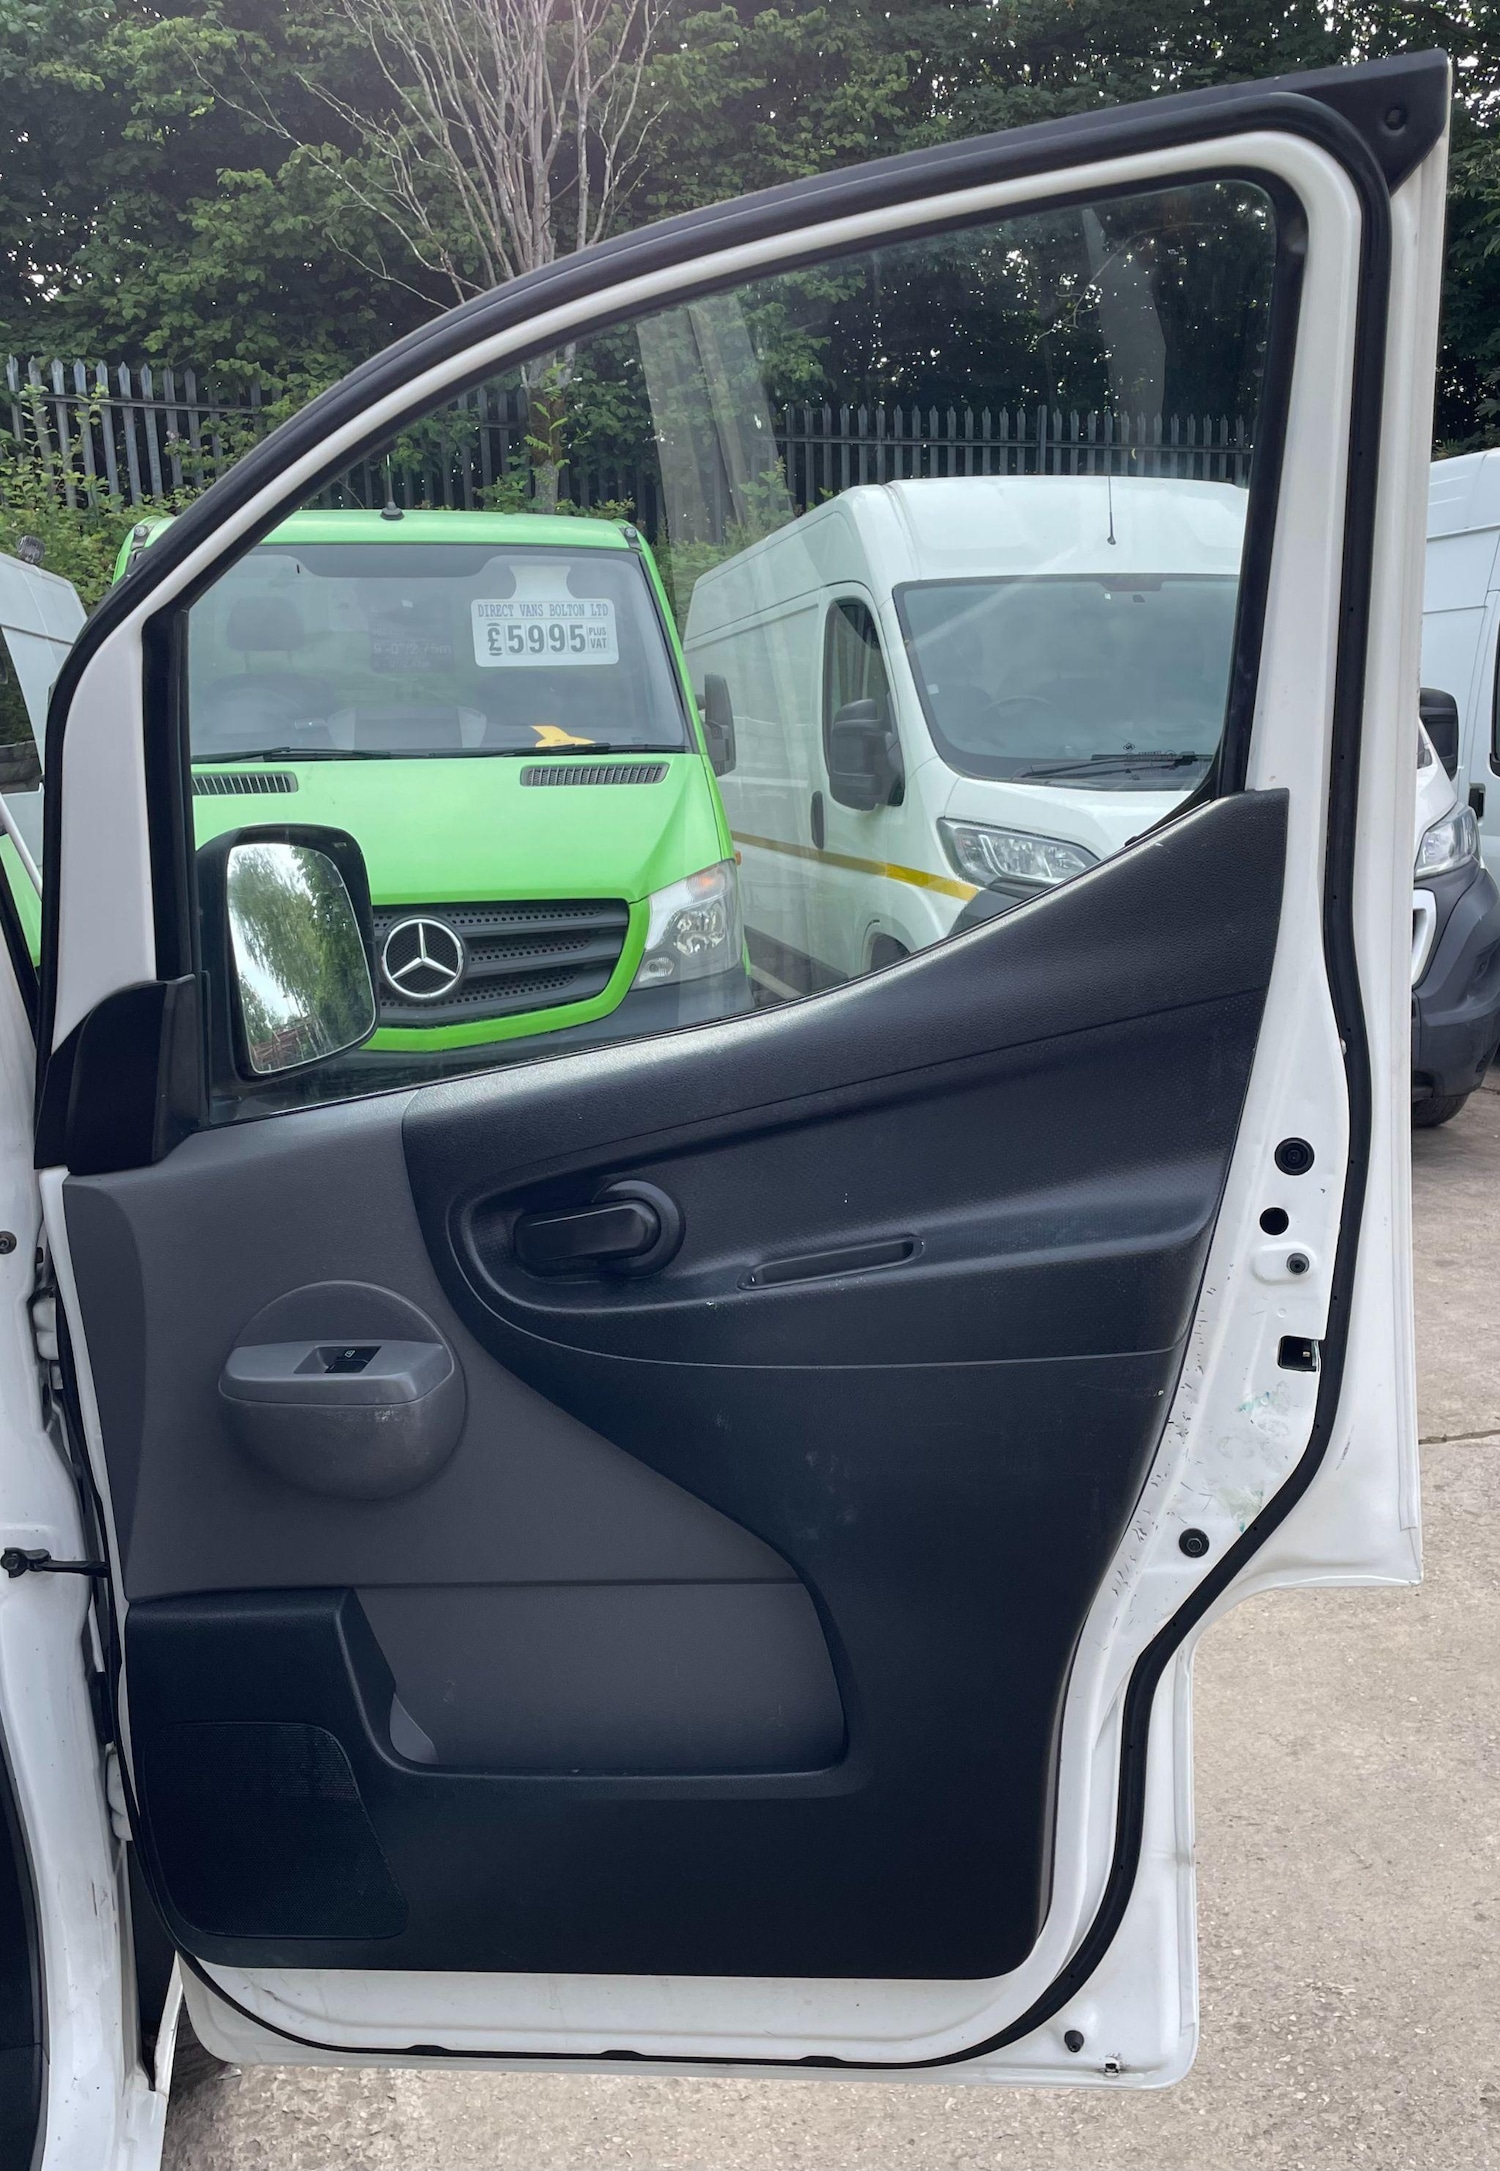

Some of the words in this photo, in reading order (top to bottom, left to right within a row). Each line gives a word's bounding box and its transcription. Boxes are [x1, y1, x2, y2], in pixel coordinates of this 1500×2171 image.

[477, 603, 514, 618] DIRECT
[519, 603, 544, 617] VANS
[549, 603, 585, 617] BOLTON
[590, 603, 609, 616] LTD
[588, 627, 607, 636] PLUS
[486, 623, 586, 654] £5995
[589, 638, 607, 649] VAT
